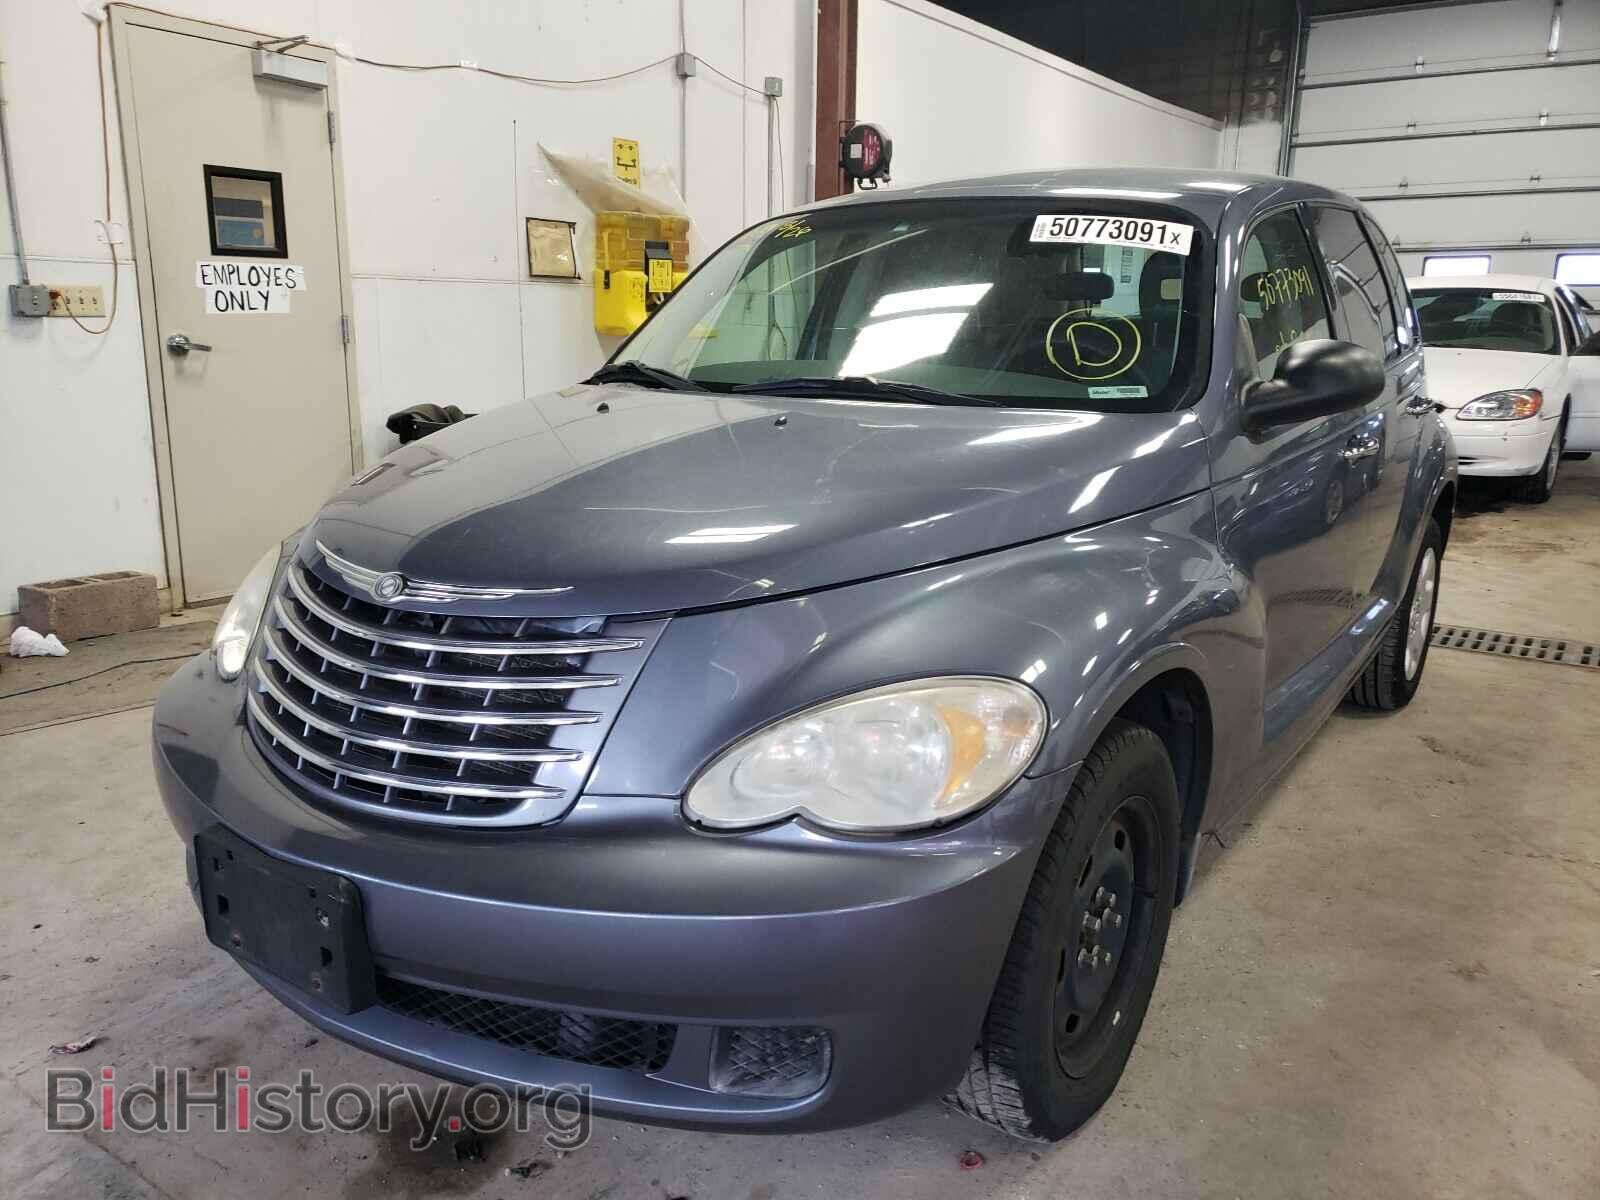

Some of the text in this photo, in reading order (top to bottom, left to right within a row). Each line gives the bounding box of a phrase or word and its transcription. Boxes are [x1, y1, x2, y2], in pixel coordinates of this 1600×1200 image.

[1049, 217, 1169, 244] 50773091
[200, 263, 297, 289] EMPLOYES
[214, 289, 270, 312] ONLY
[1066, 322, 1122, 367] D
